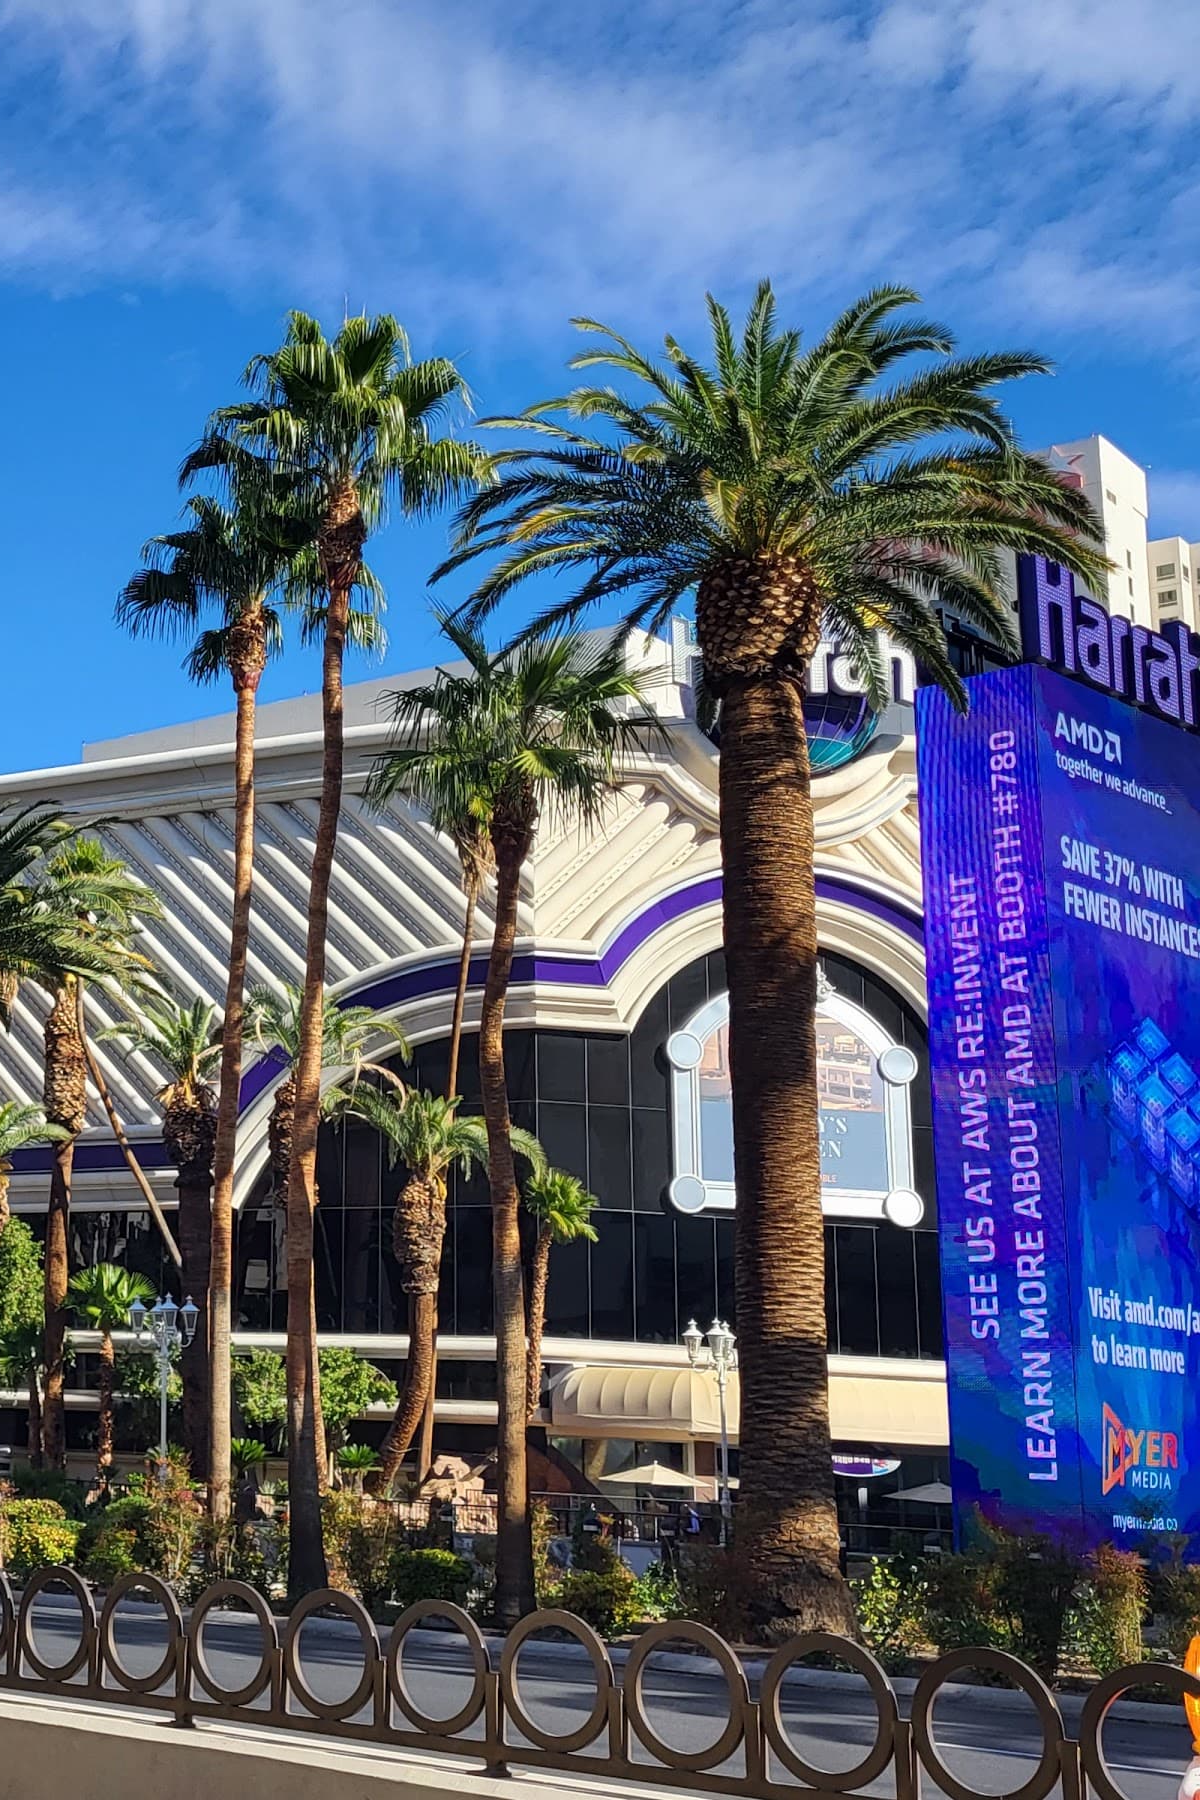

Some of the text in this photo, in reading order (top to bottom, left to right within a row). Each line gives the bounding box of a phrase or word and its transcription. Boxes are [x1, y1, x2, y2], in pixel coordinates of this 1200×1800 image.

[1054, 712, 1103, 755] AMD
[1056, 750, 1103, 785] together
[1104, 772, 1121, 792] we
[1060, 835, 1185, 911] SAVE 37% WITH
[1063, 881, 1122, 933] FEWER
[950, 874, 1000, 1340] SEE US AT AWS RE:INVENT
[988, 729, 1058, 1481] LEARN MORE ABOUT AMD AT BOOTH #780
[1088, 1286, 1122, 1322] Visit
[1091, 1333, 1185, 1375] to learn more
[1107, 1426, 1179, 1487] MYER
[1131, 1470, 1172, 1490] MEDIA
